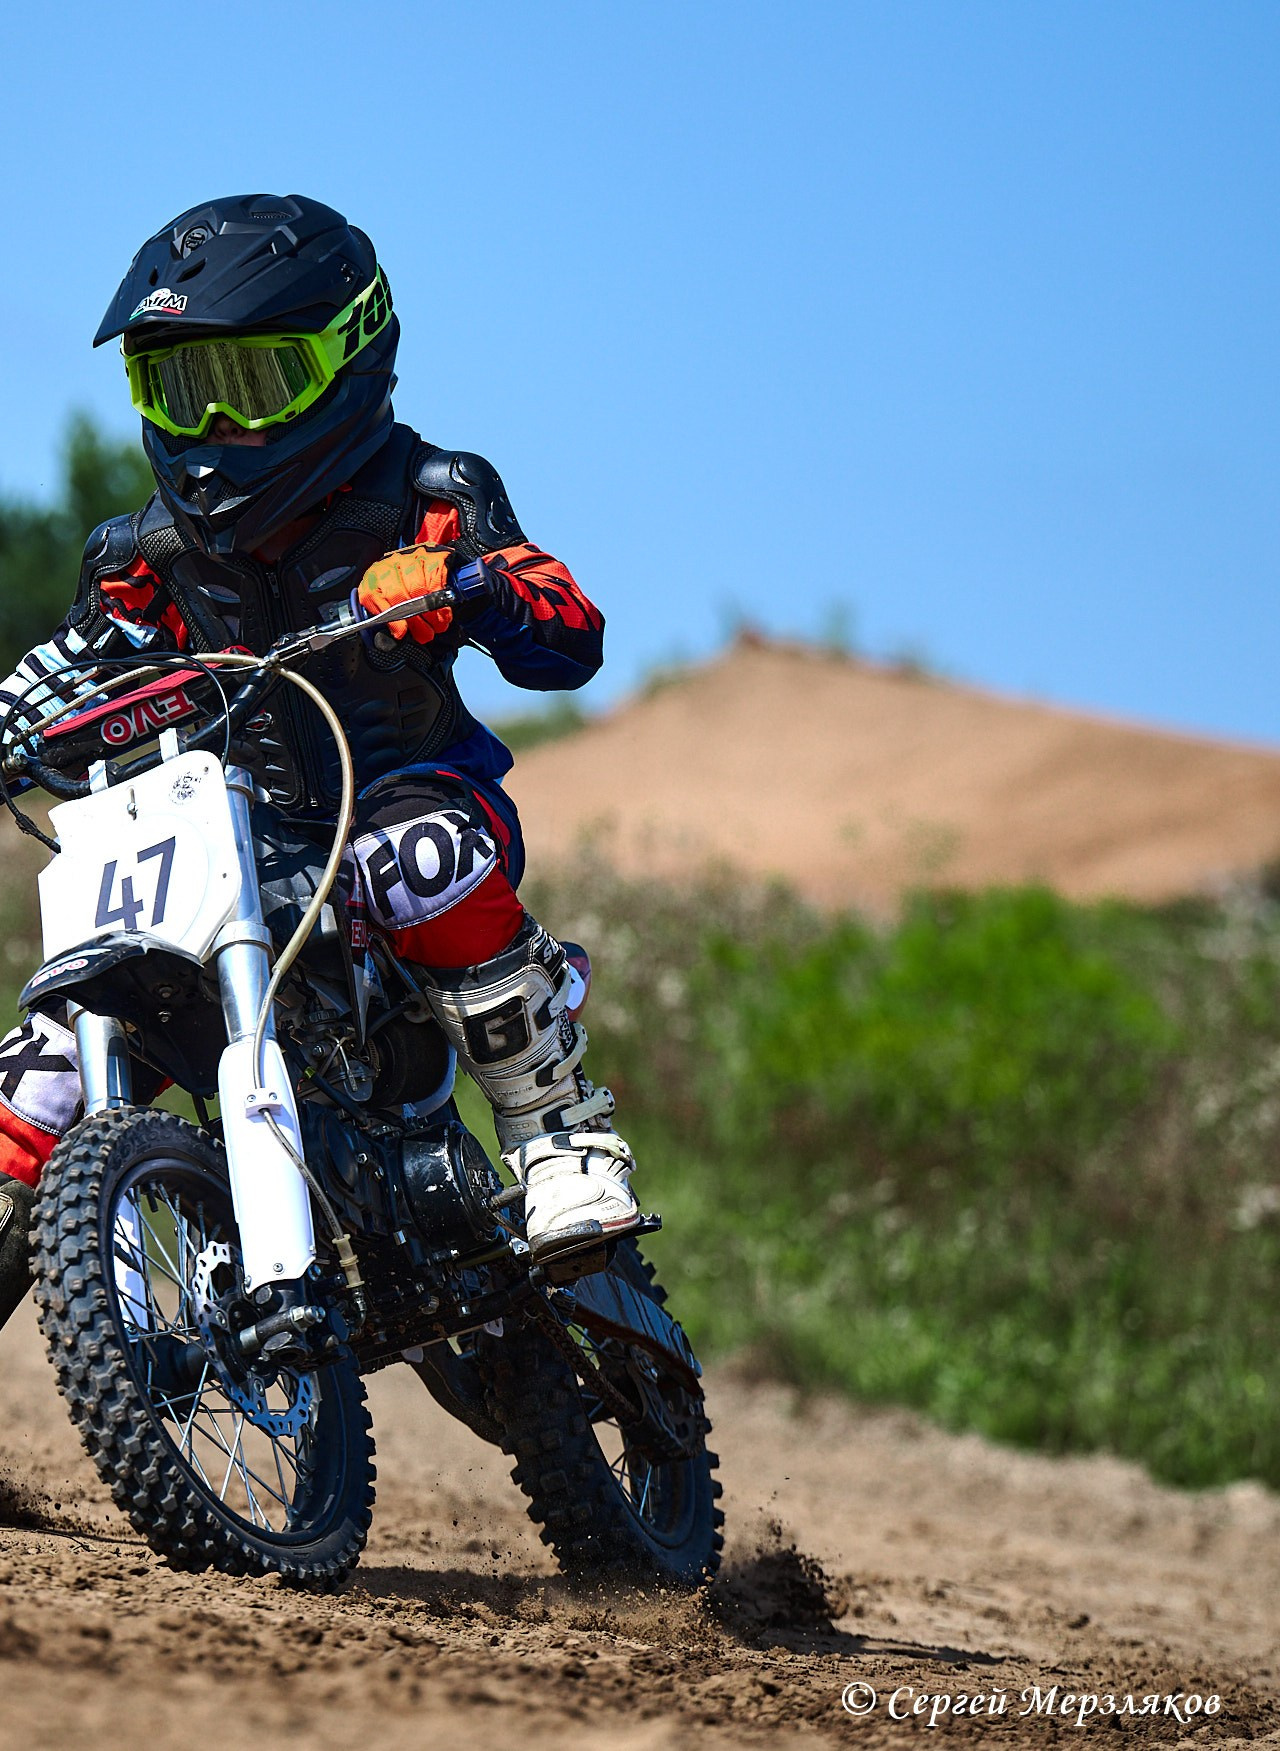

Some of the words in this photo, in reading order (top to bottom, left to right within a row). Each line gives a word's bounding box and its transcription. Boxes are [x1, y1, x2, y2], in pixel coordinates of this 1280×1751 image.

[100, 687, 199, 745] EVO
[95, 835, 176, 930] 47
[365, 812, 494, 920] FOX
